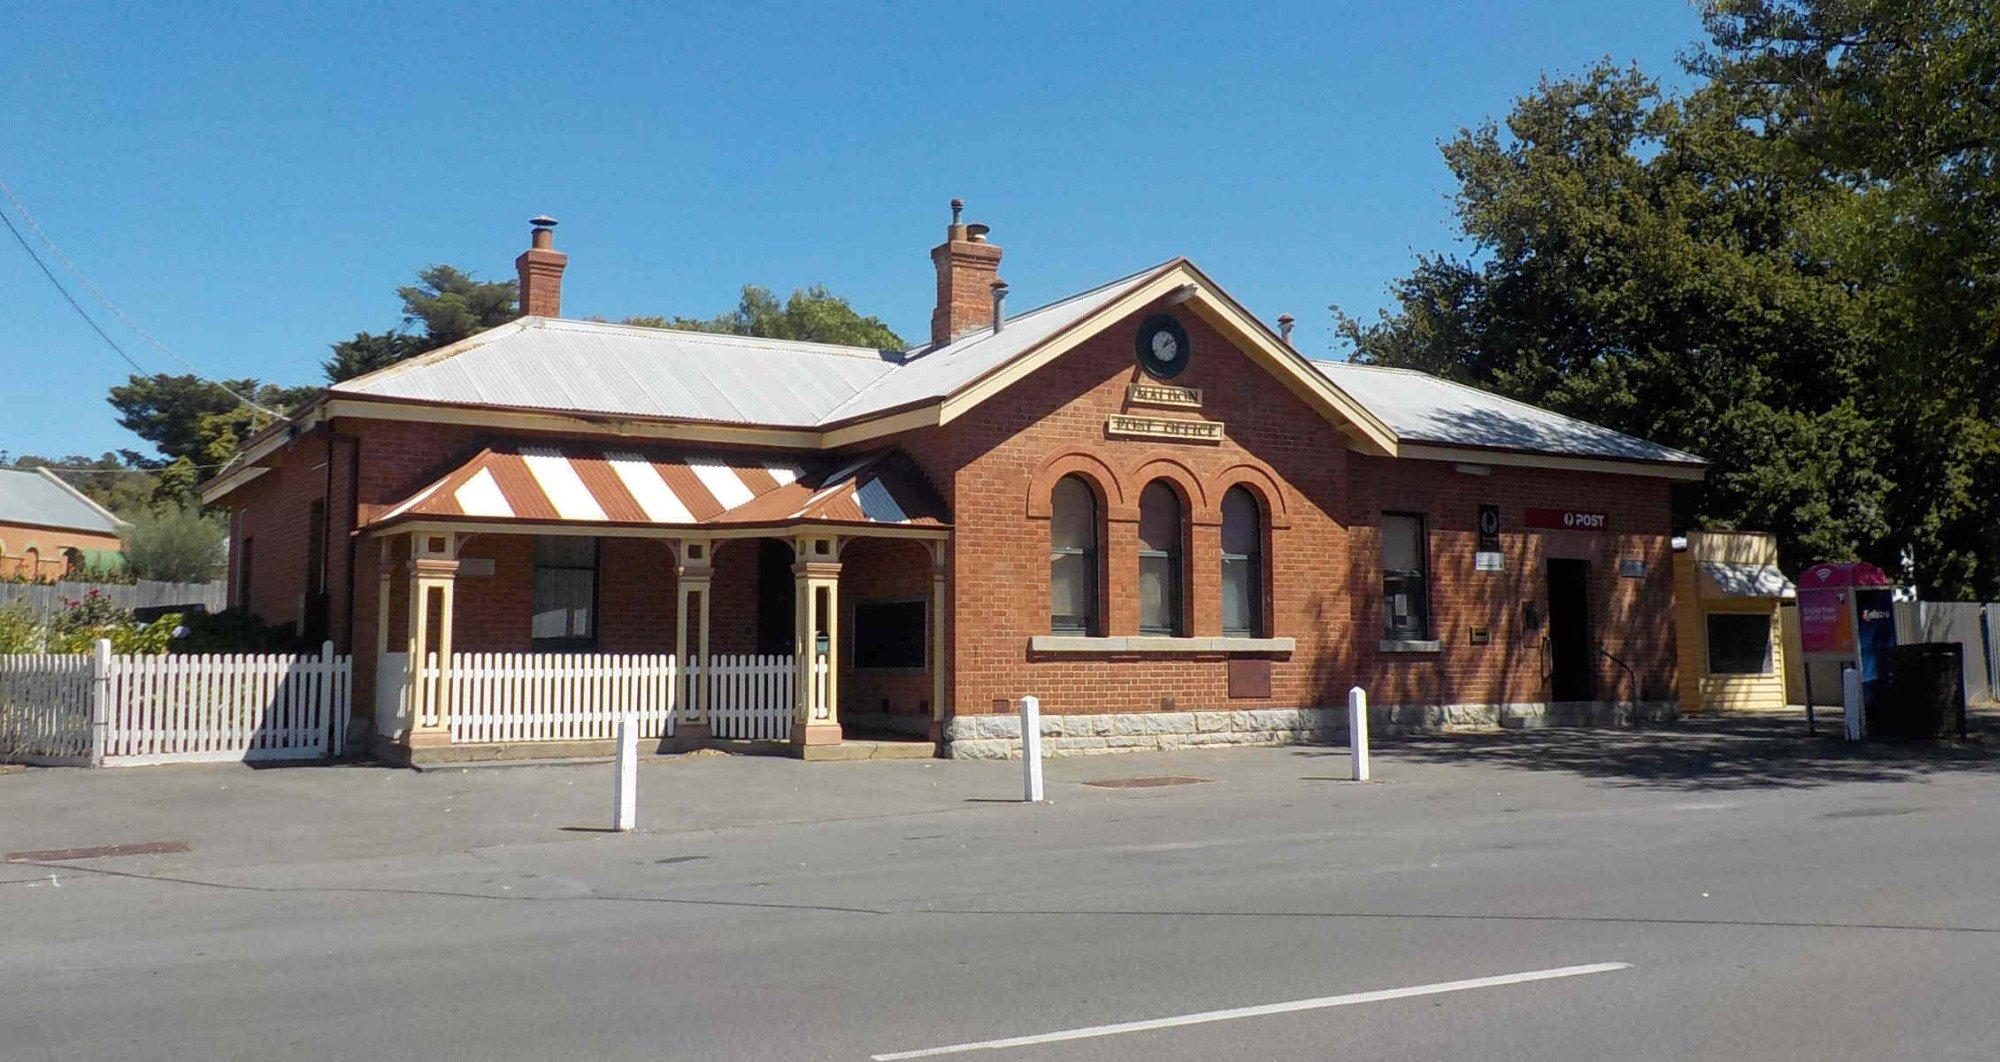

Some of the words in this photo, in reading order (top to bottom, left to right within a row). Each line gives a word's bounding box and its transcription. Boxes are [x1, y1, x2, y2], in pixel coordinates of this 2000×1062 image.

[1117, 419, 1150, 433] POST
[1165, 421, 1216, 437] OFFICE
[1575, 513, 1605, 527] POST
